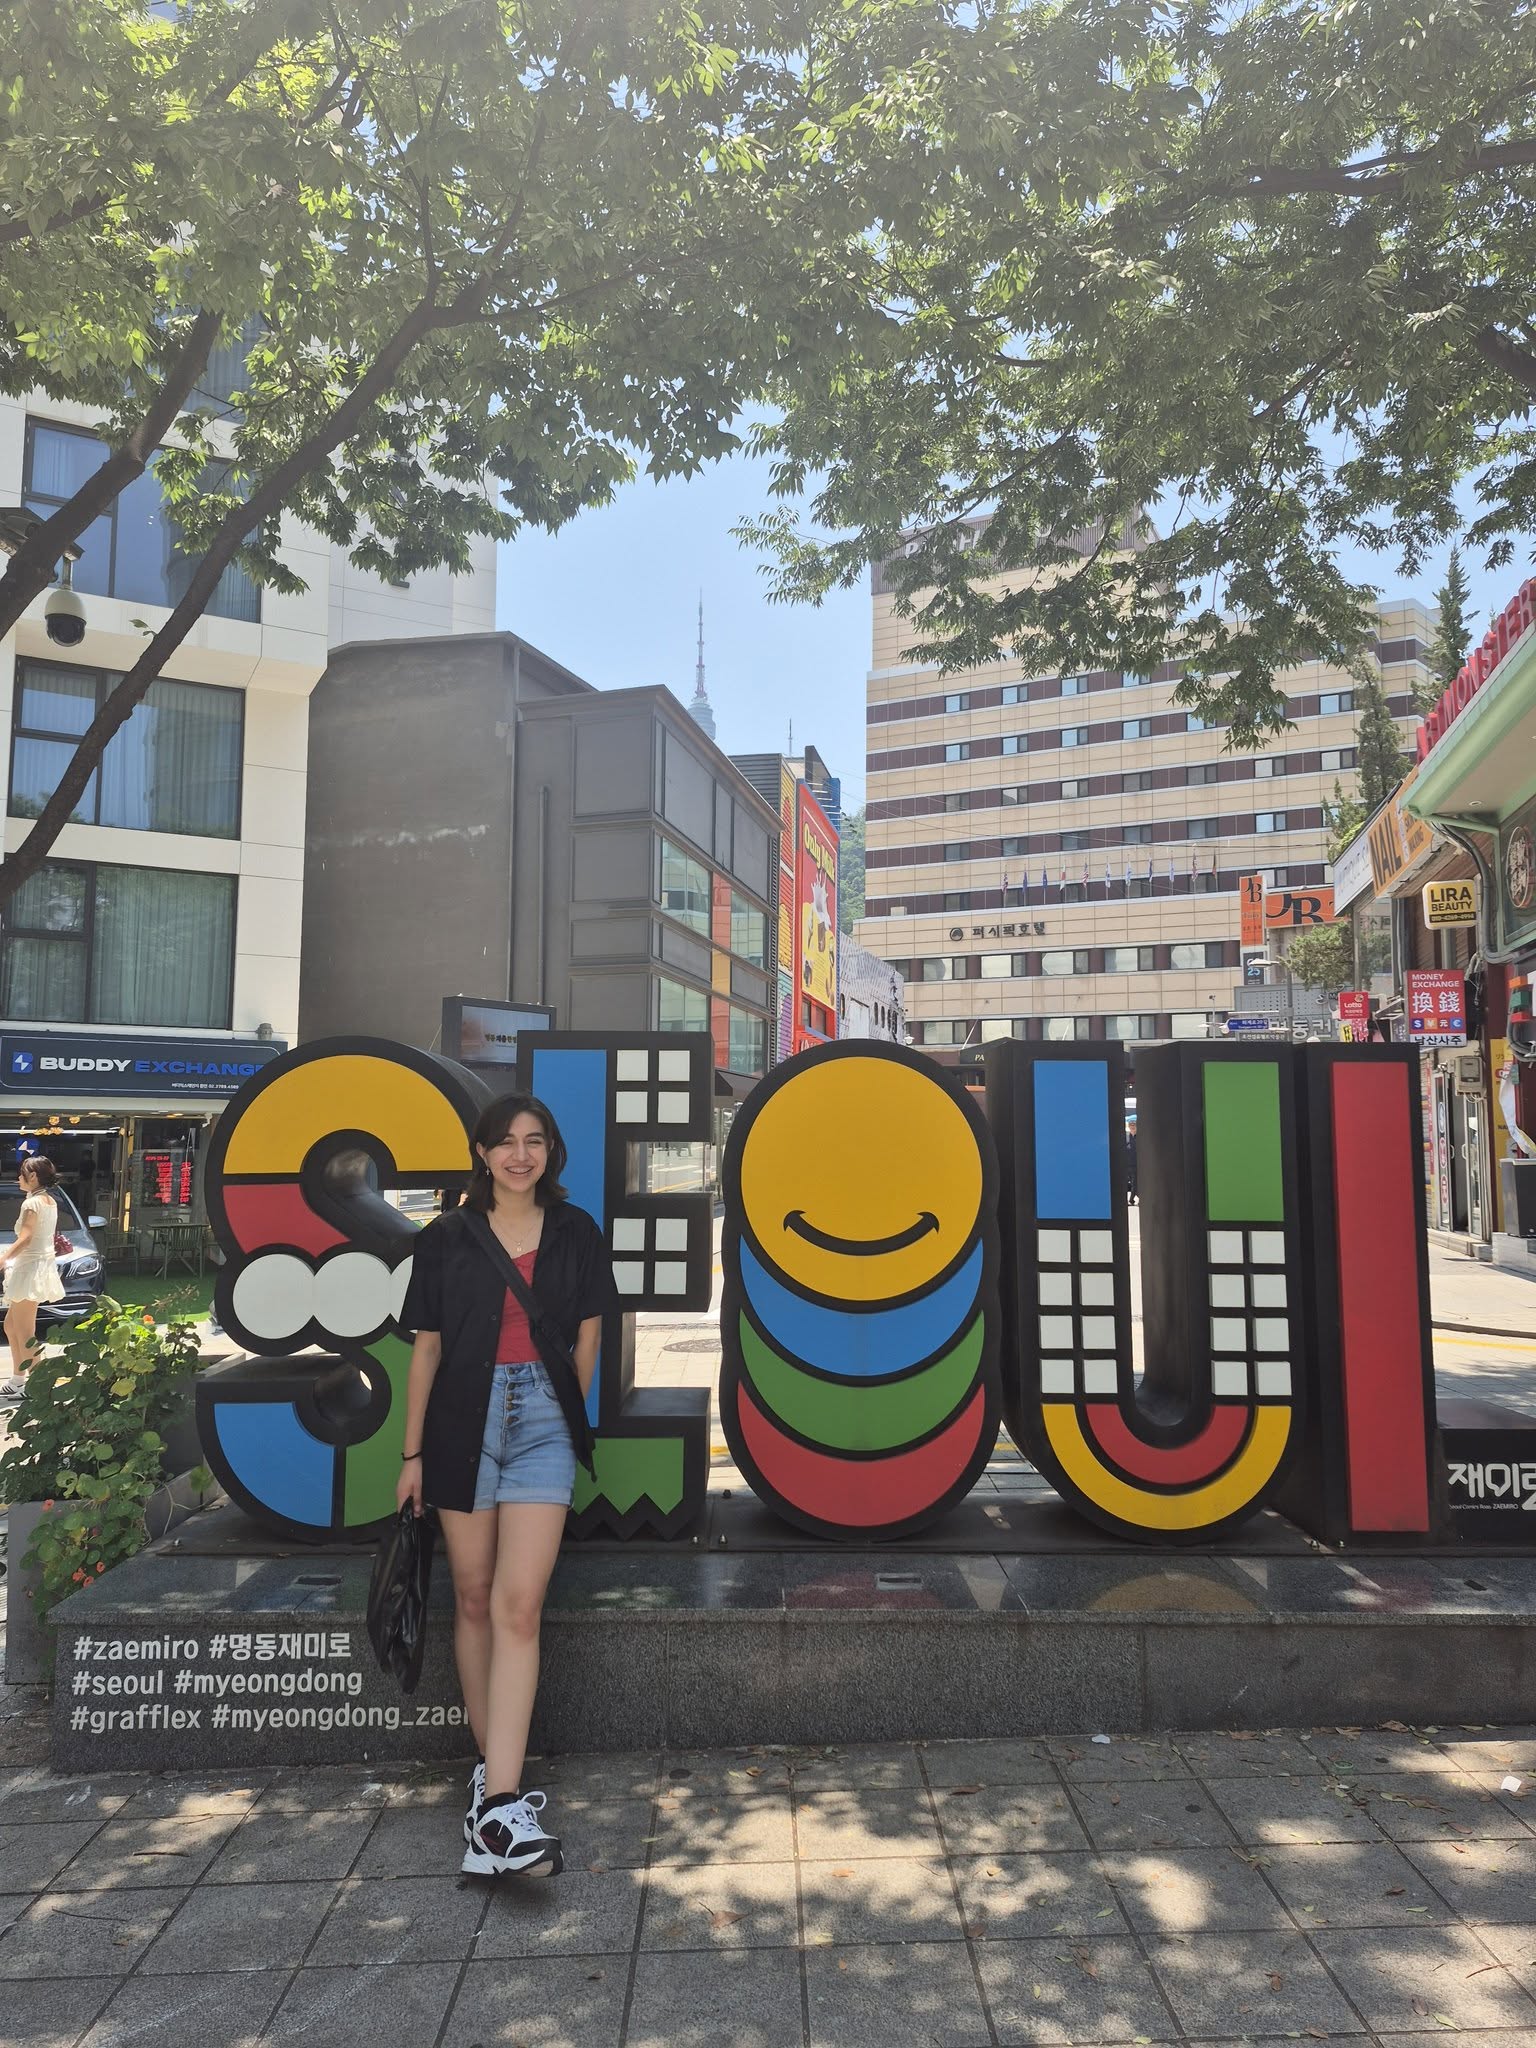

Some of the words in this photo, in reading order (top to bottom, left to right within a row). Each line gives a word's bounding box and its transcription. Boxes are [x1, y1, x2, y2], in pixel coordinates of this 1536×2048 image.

[1369, 812, 1402, 892] NAIL
[1431, 887, 1472, 903] LIRA
[1431, 901, 1473, 912] BEAUTY
[972, 922, 1046, 939] 퍼시픽호텔
[1412, 980, 1460, 988] EXCHANGE
[1415, 1034, 1462, 1046] 남산사주
[40, 1057, 132, 1072] BUDDY
[134, 1060, 265, 1076] EXCHANG
[73, 1635, 200, 1661] #zaemiro
[208, 1632, 352, 1660] #명동재미로
[71, 1669, 163, 1695] #seoul
[174, 1668, 362, 1698] #myeongdong
[70, 1704, 202, 1734] #grafflex
[211, 1702, 469, 1732] #myeongdong_zae
